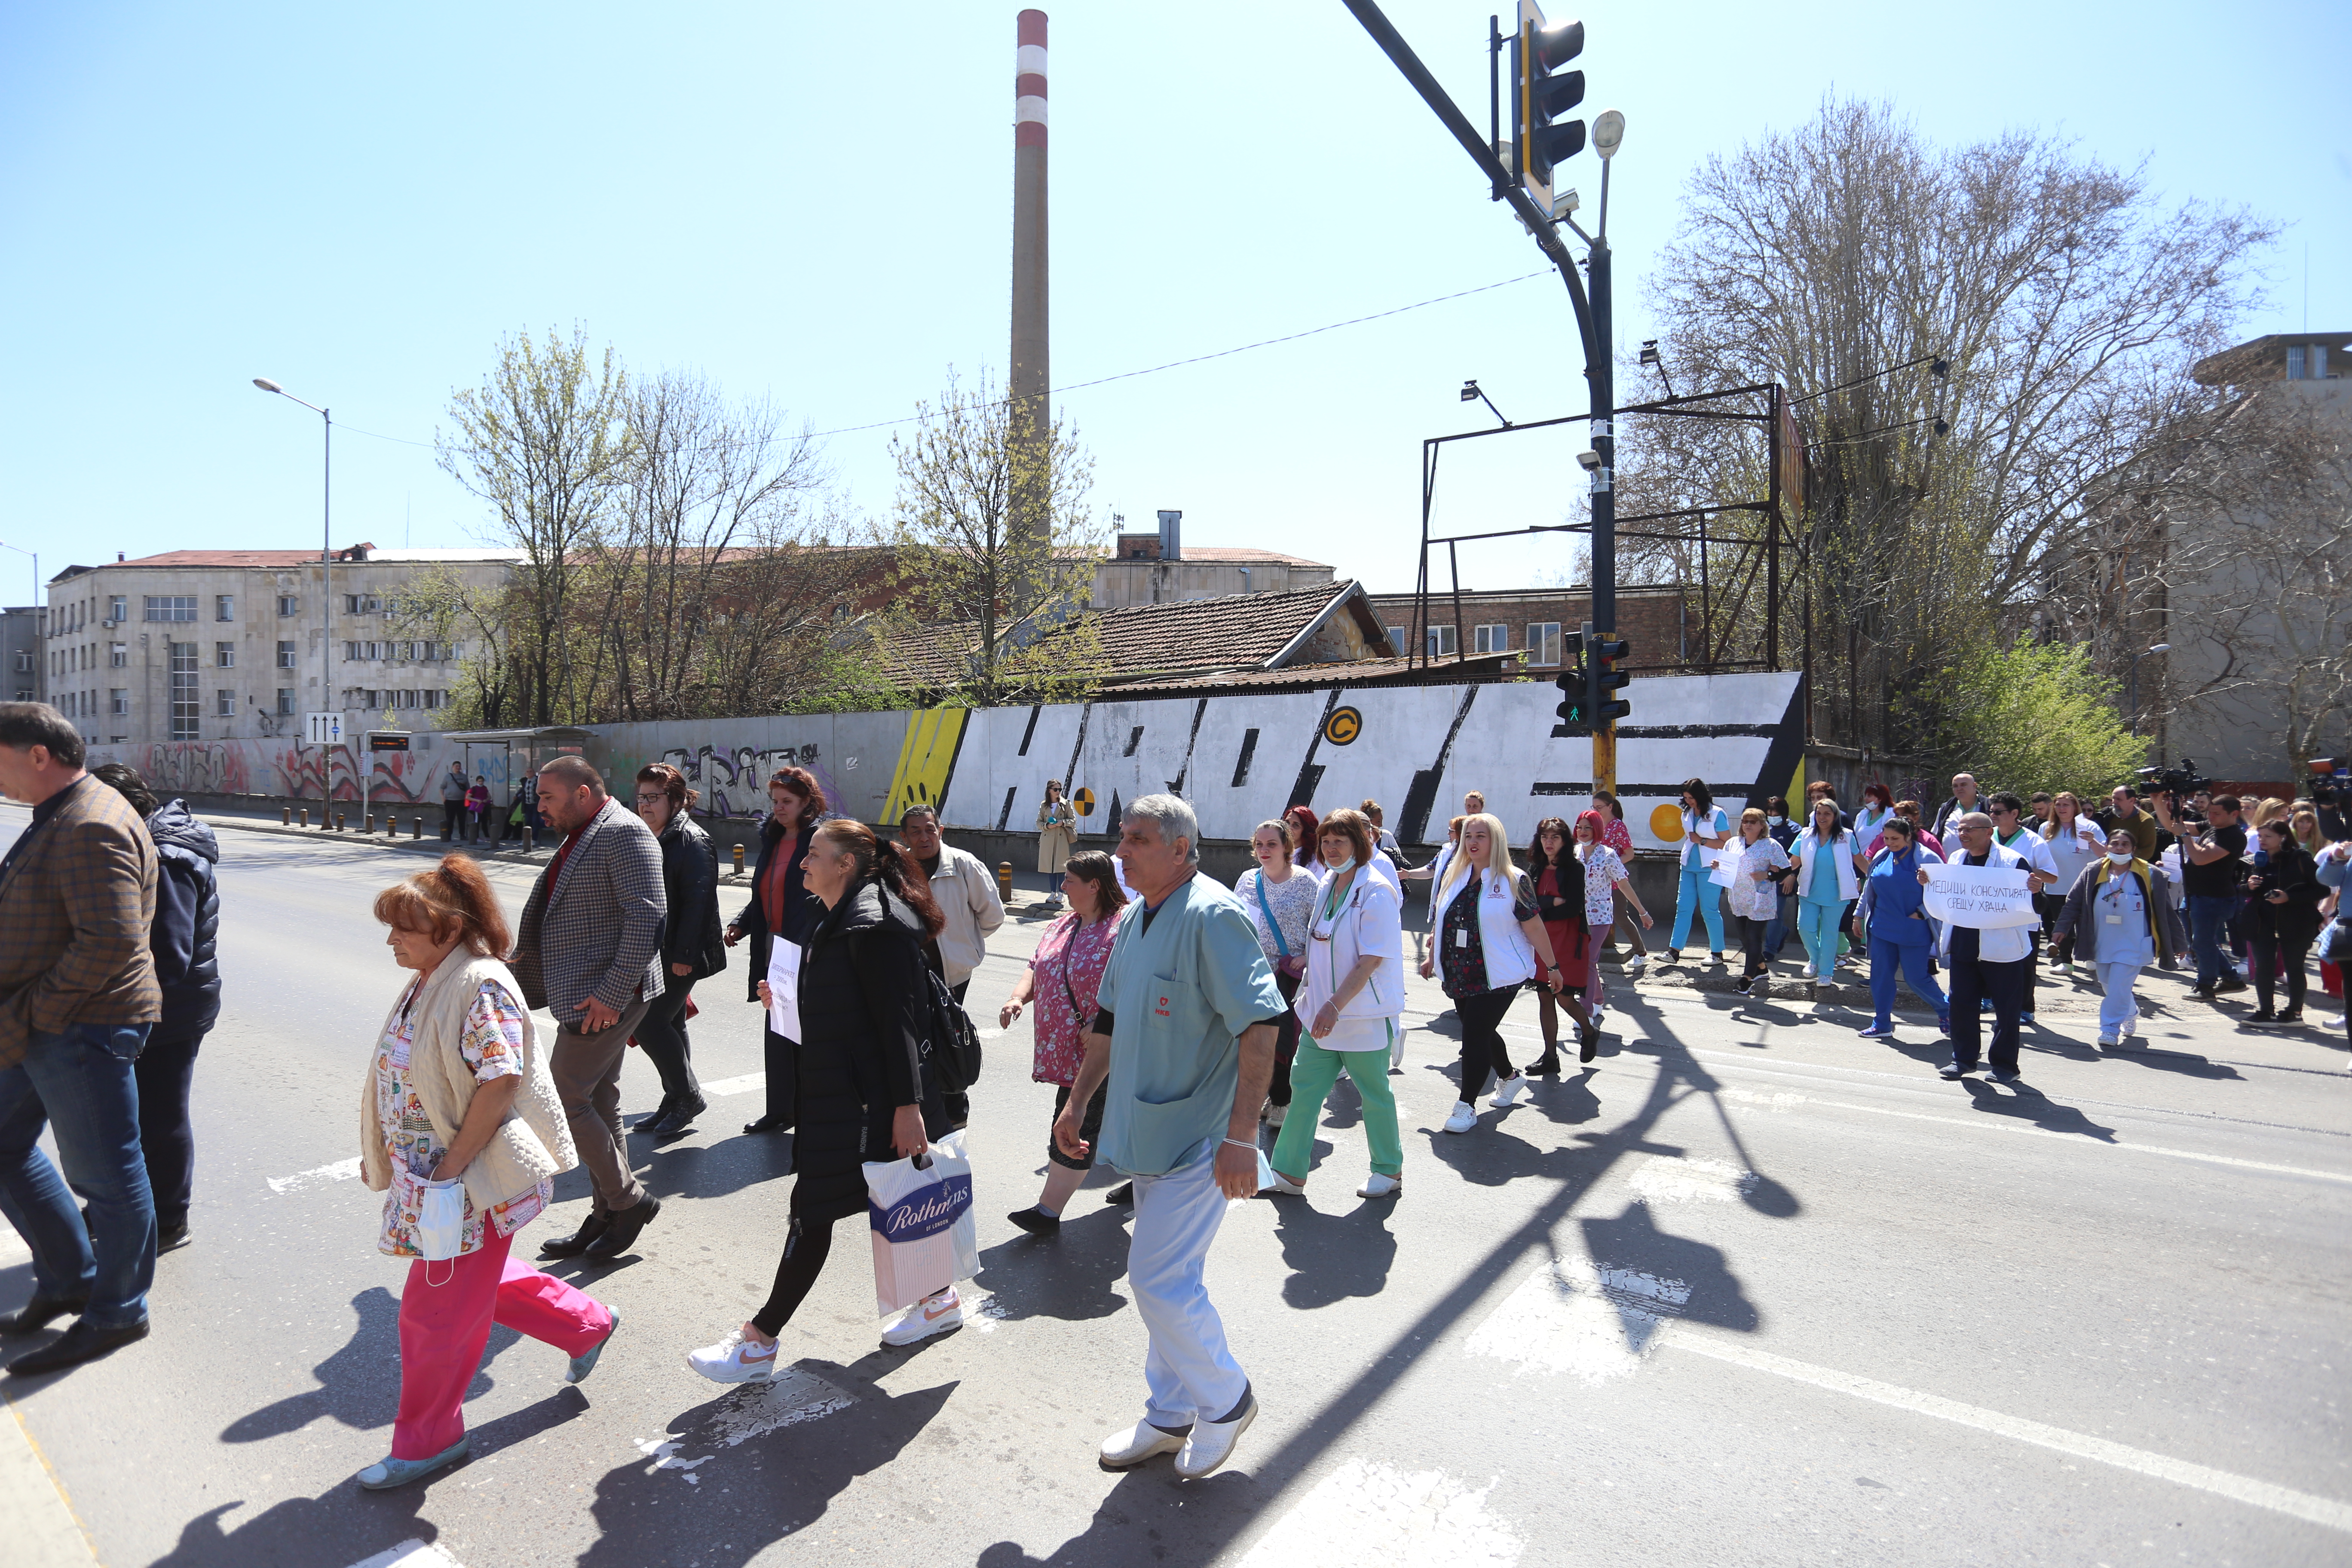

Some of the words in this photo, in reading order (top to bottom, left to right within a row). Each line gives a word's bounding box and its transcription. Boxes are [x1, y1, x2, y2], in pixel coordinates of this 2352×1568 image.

[1927, 880, 1966, 895] МЕДИЦИ
[1971, 885, 2028, 899] КОНСУЛТИРАТ
[1947, 897, 1974, 911] СРЕЩУ
[1978, 901, 2009, 913] ХРАНА
[1155, 1008, 1170, 1017] НКБ
[932, 1219, 949, 1229] LONDON
